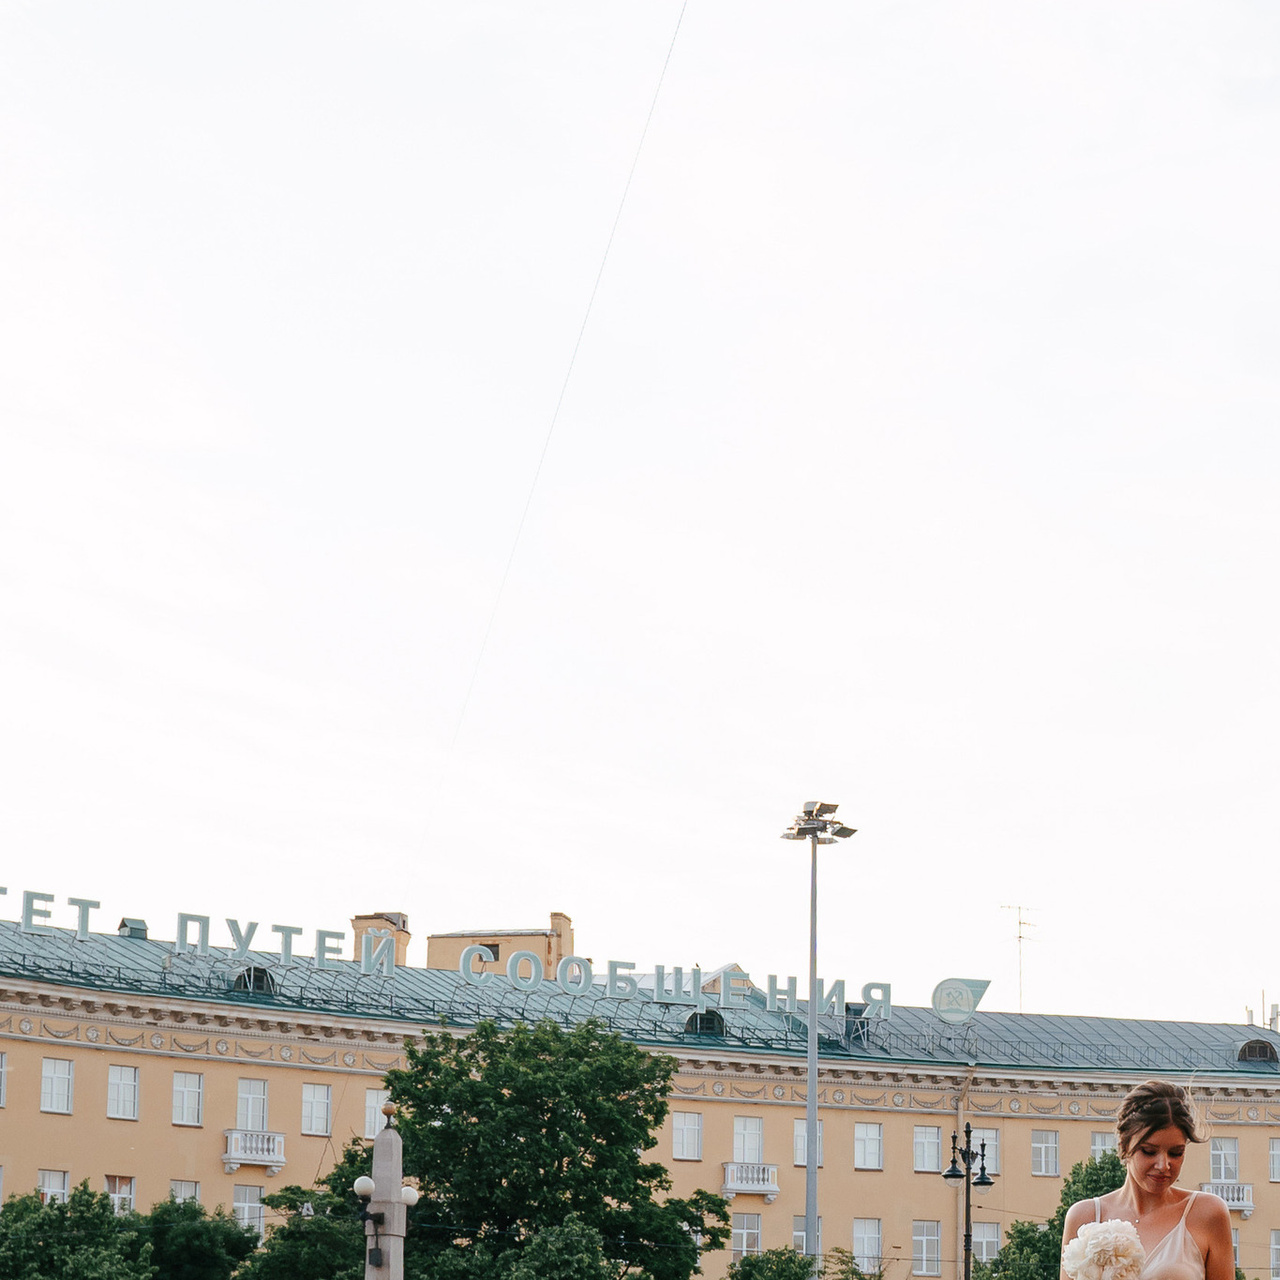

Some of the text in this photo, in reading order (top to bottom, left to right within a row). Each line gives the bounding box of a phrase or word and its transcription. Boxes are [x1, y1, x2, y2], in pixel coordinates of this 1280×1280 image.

[0, 886, 891, 1019] ЕТ ПУТЕЙ СООБЩЕНИЯ
